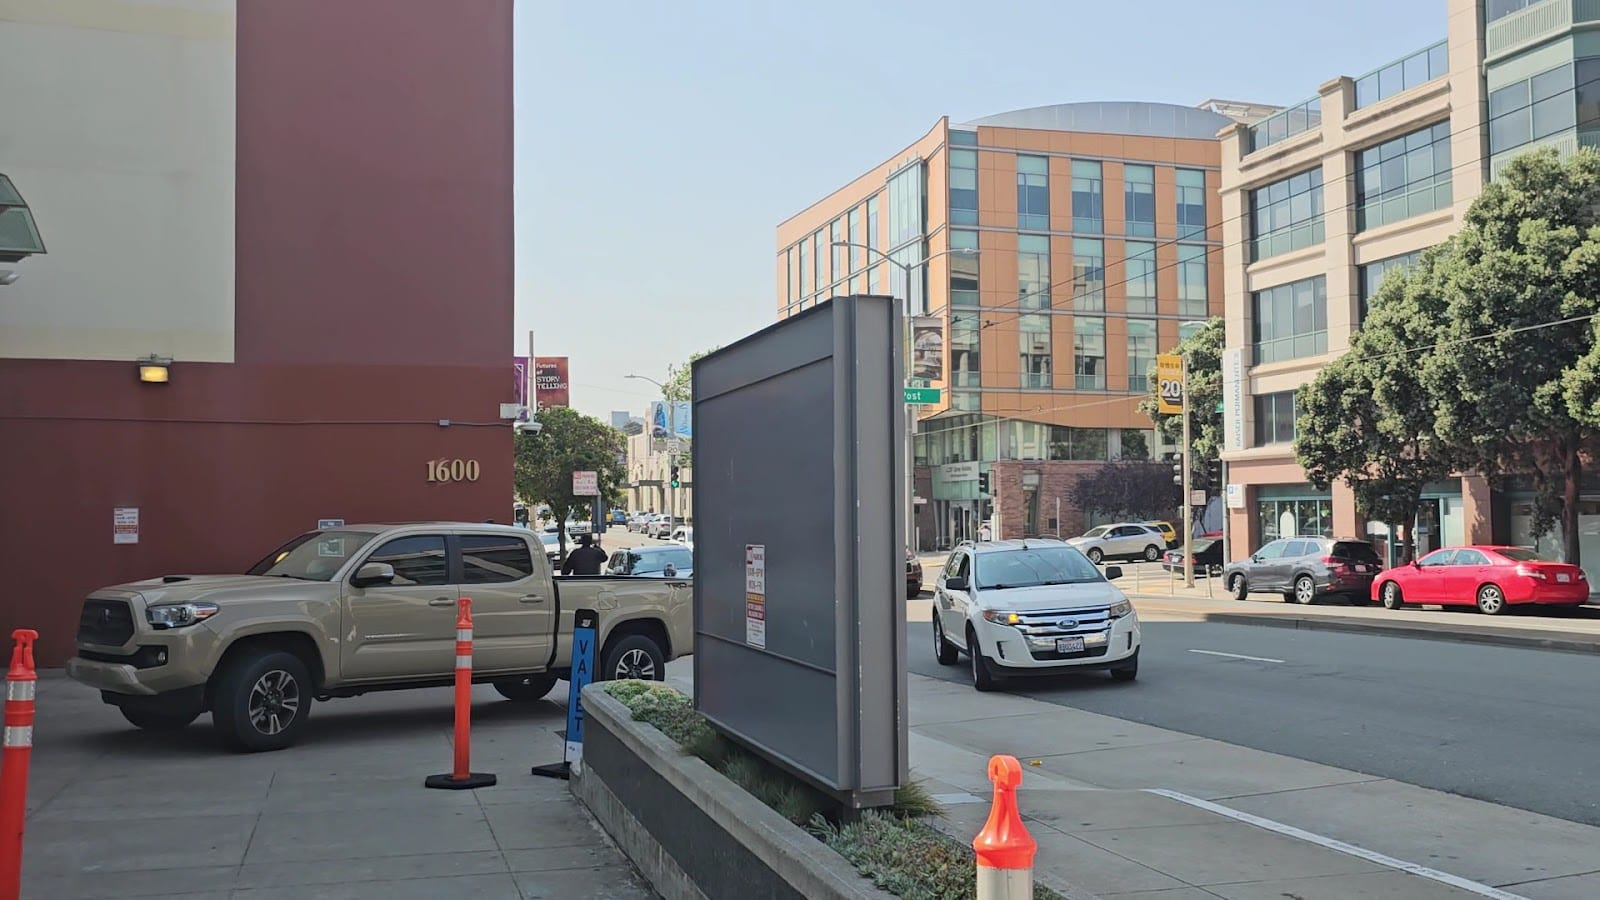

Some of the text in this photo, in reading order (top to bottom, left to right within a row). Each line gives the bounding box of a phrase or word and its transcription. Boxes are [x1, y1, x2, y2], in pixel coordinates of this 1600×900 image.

[536, 375, 560, 383] STORY
[1161, 380, 1180, 397] 20
[904, 391, 921, 401] ost
[426, 459, 480, 481] 1600
